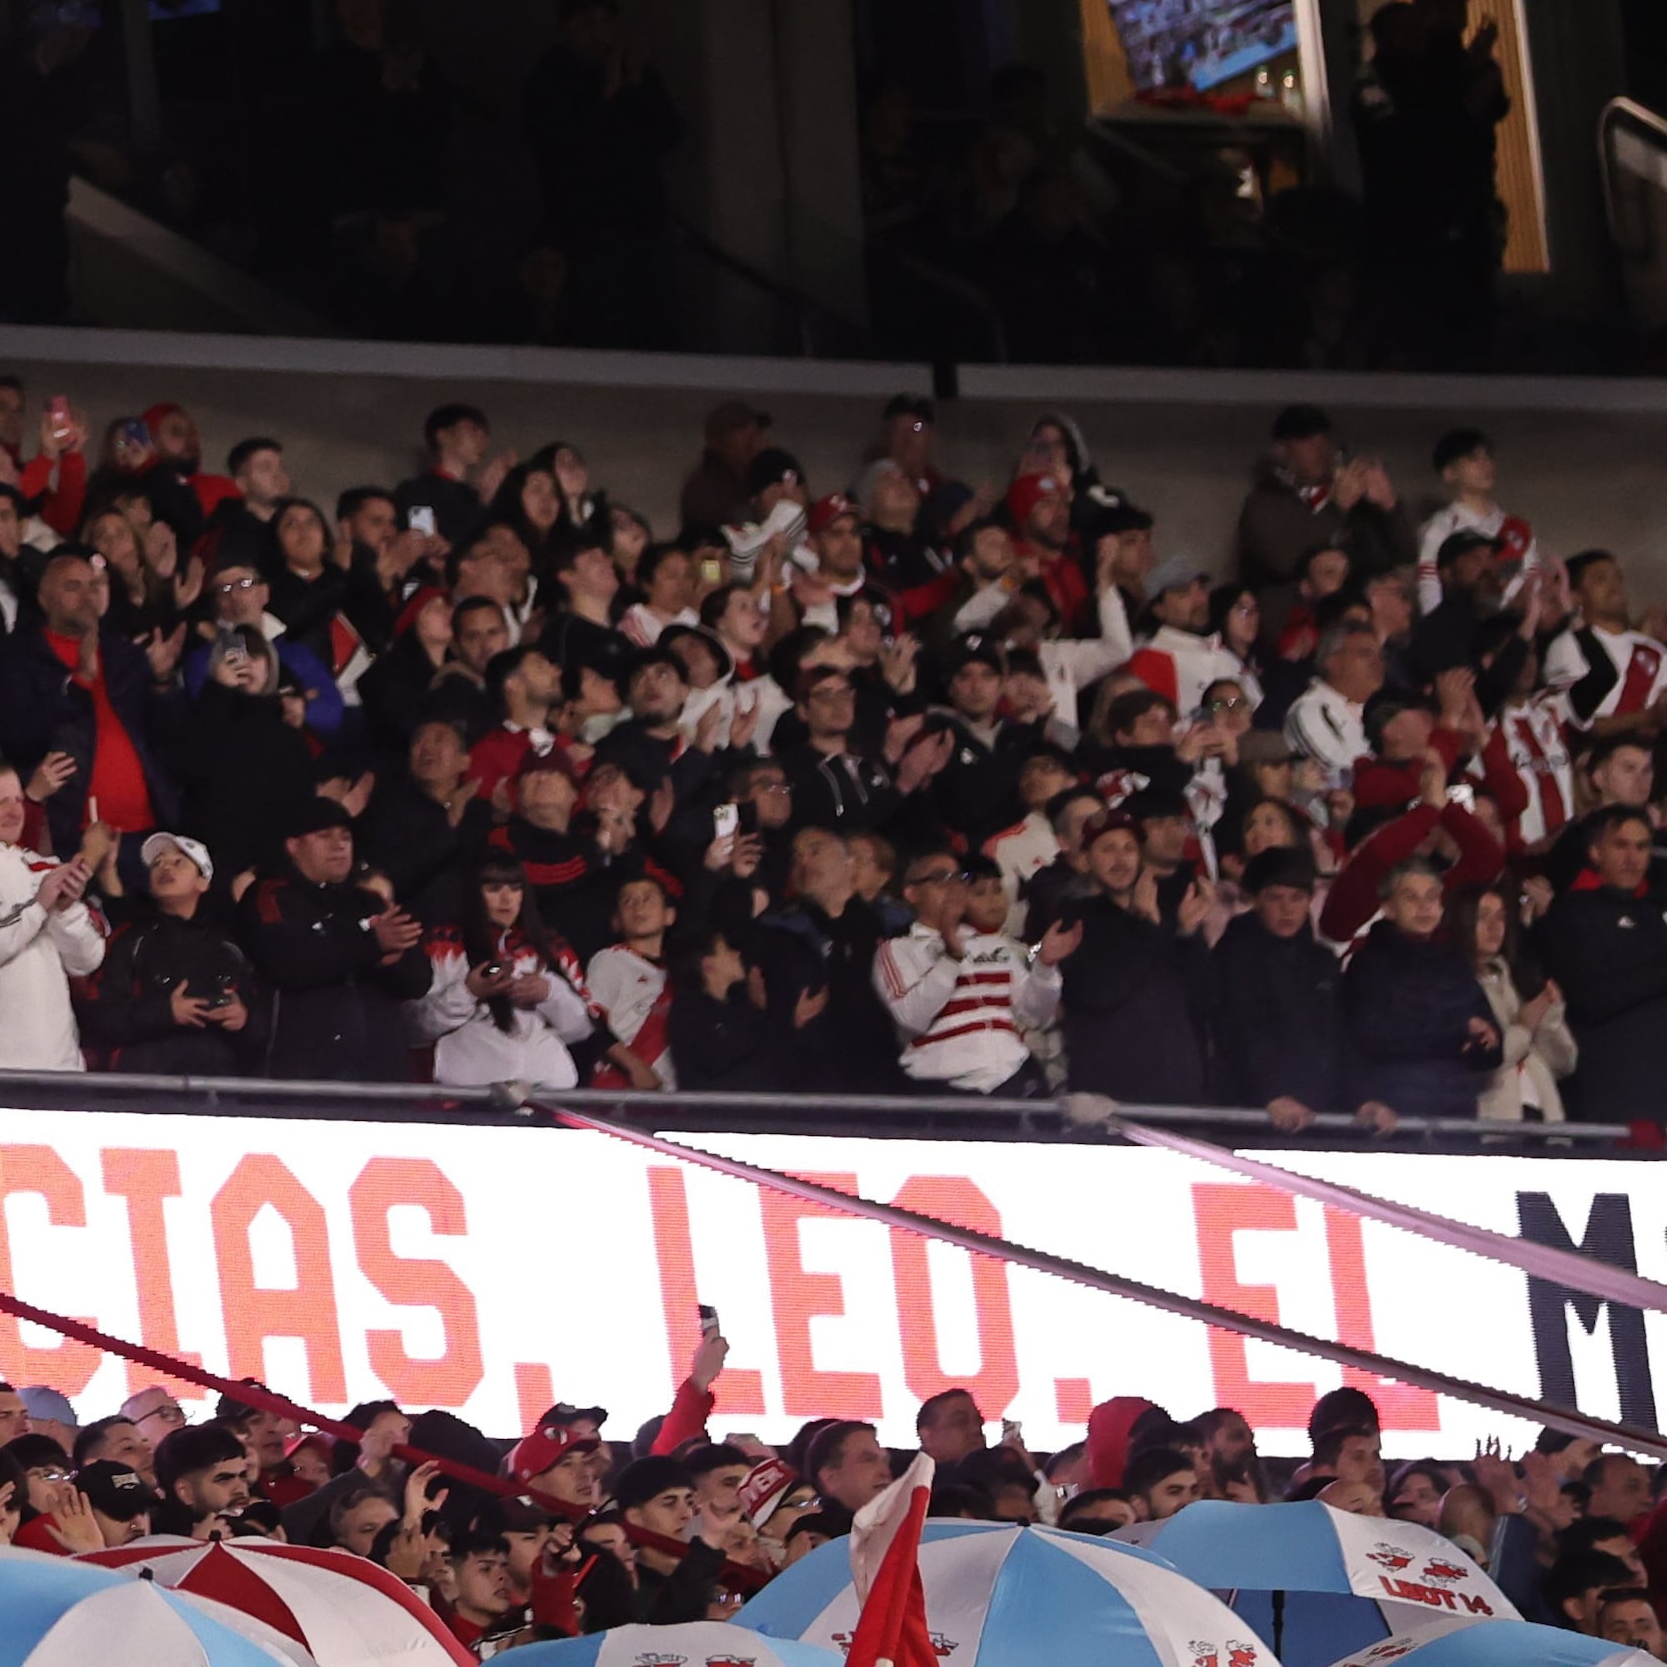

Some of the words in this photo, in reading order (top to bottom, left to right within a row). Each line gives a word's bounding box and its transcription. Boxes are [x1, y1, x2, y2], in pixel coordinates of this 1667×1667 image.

[647, 1166, 1092, 1426] LEO.
[1191, 1182, 1441, 1432] EL
[1515, 1191, 1667, 1446] M
